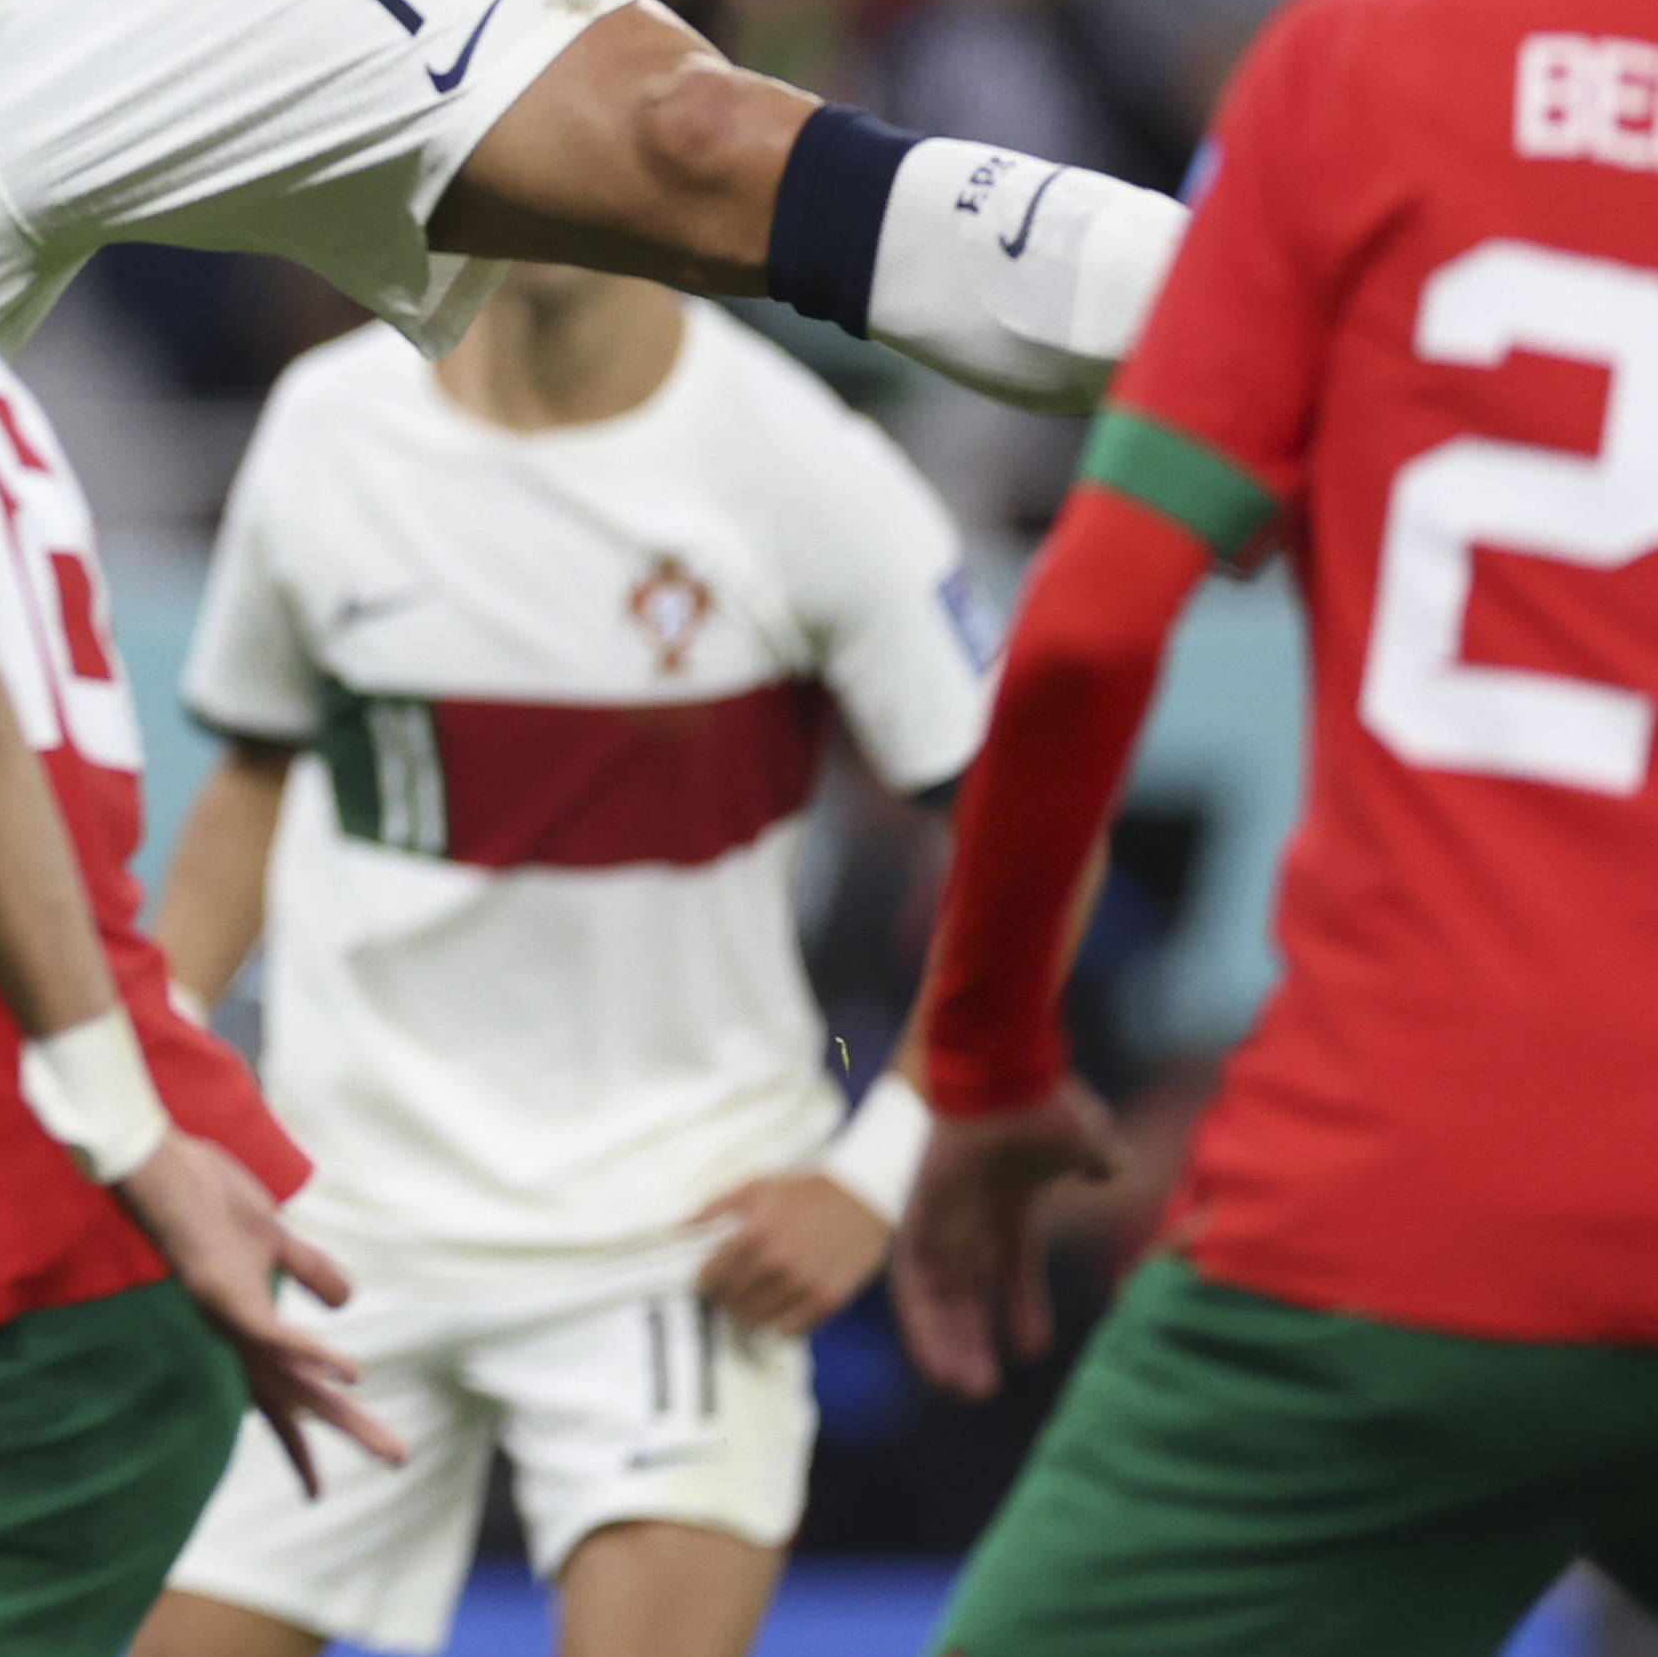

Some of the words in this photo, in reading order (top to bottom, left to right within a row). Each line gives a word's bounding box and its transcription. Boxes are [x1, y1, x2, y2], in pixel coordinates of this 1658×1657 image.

[1514, 30, 1658, 173] BE
[1356, 235, 1658, 799] 2
[369, 696, 449, 855] 11
[645, 1294, 717, 1420] 11
